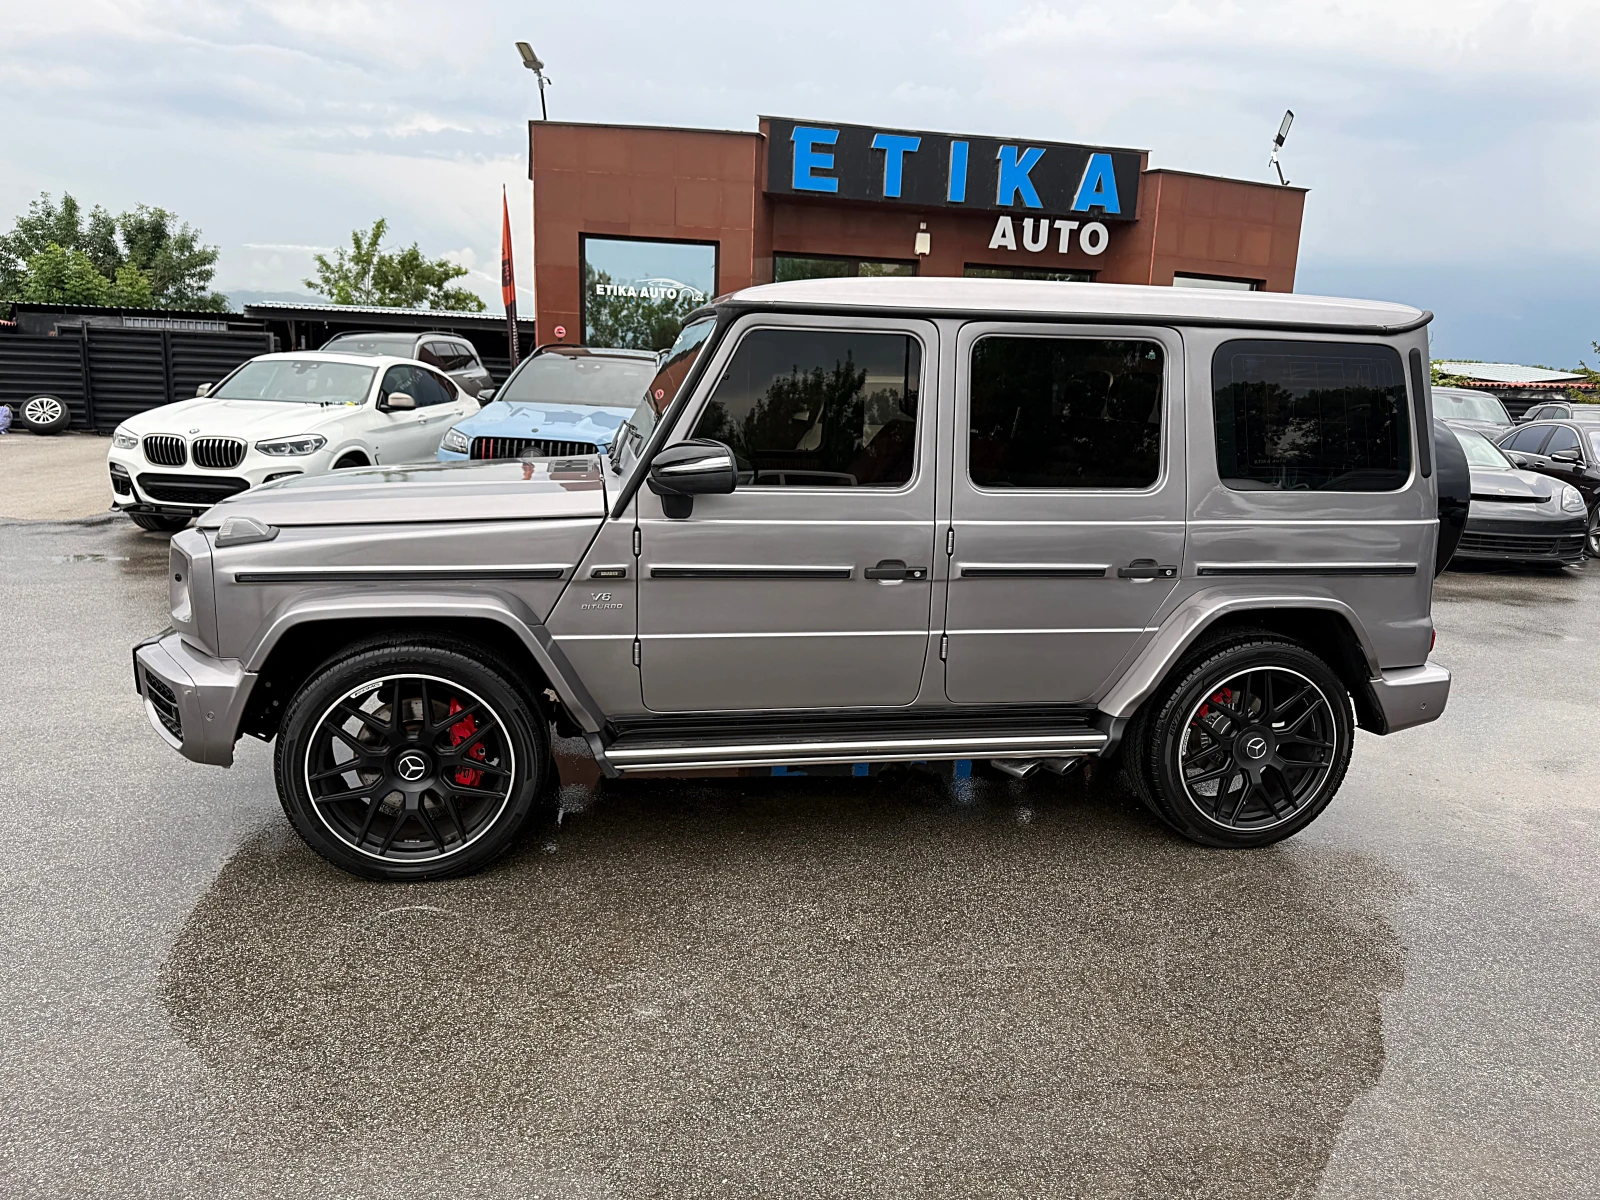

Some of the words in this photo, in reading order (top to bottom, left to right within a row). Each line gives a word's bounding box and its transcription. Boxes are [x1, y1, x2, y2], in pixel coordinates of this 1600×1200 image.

[790, 125, 1121, 214] ETIKA
[988, 215, 1109, 256] AUTO
[596, 284, 636, 298] ETIKA
[640, 286, 677, 300] AUTO
